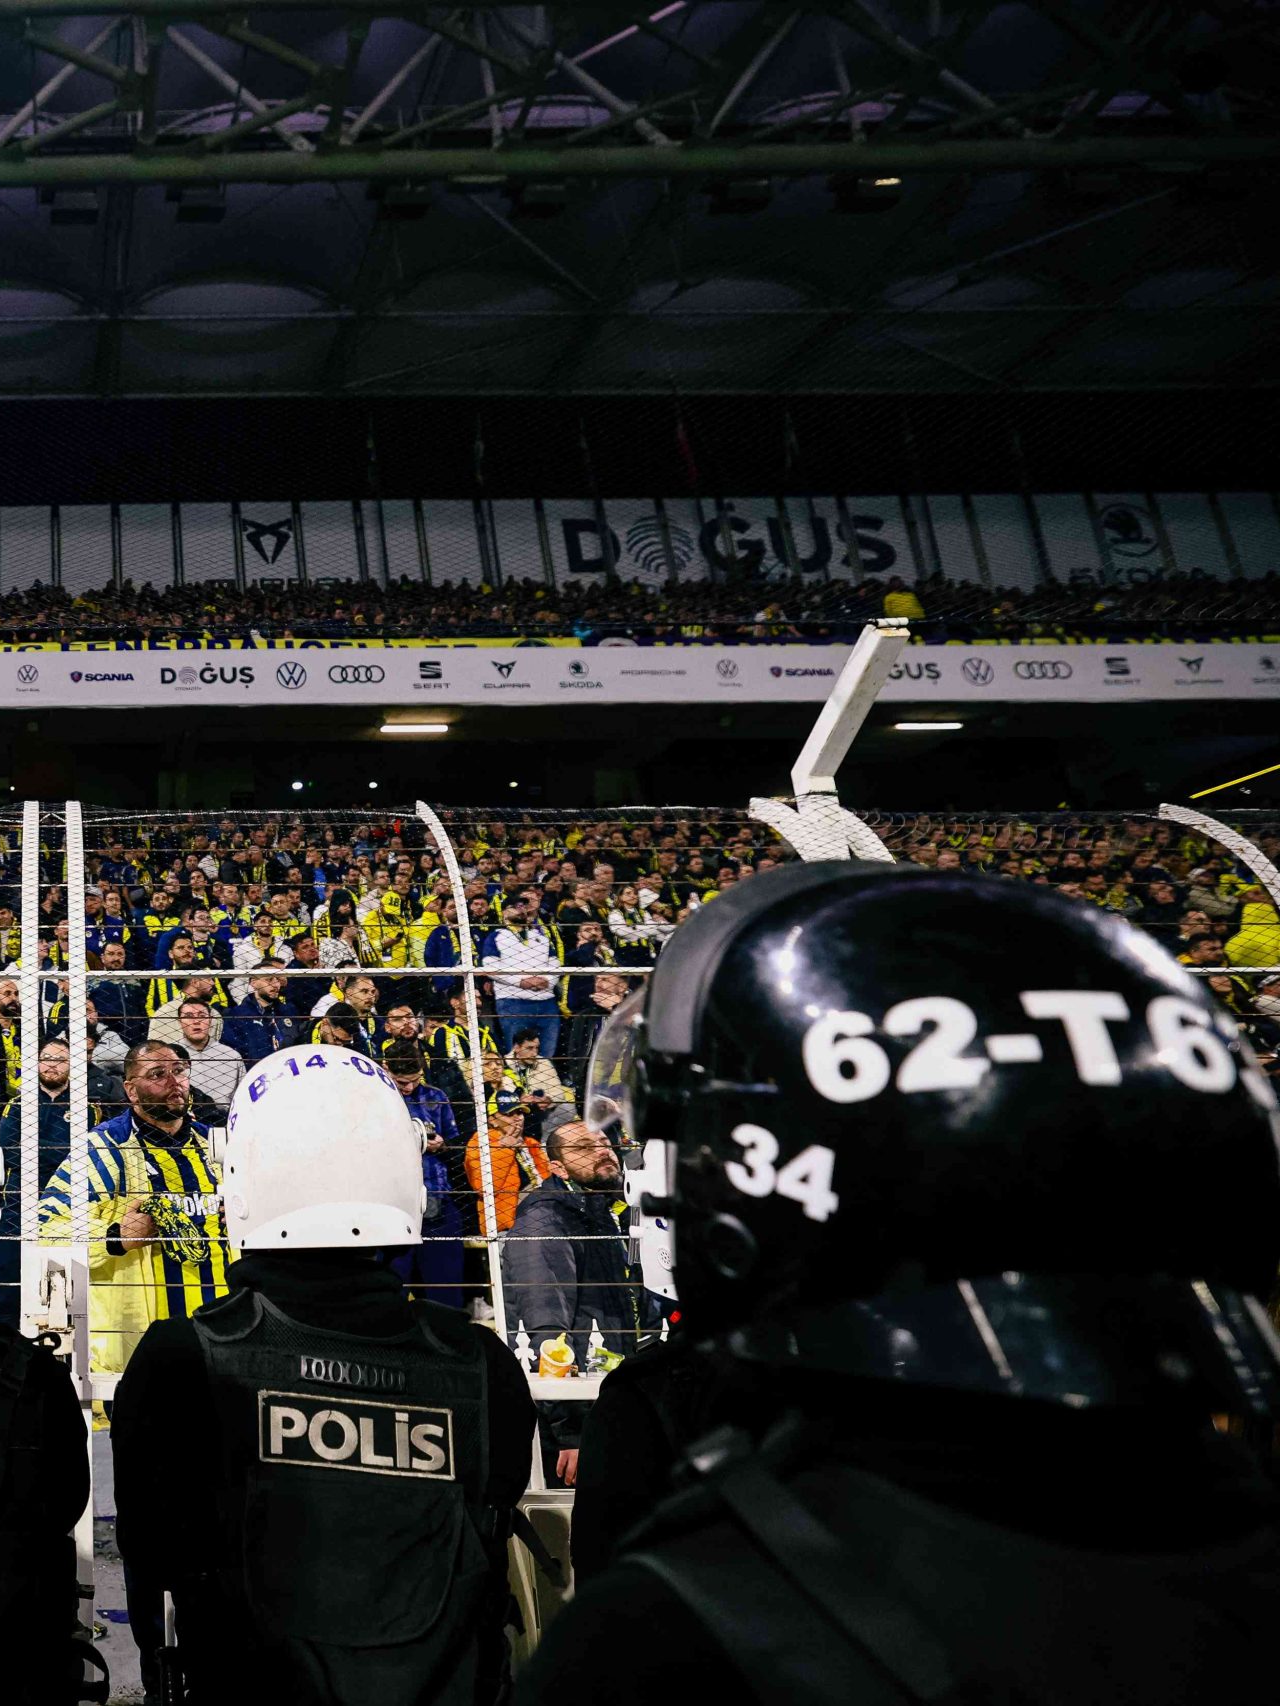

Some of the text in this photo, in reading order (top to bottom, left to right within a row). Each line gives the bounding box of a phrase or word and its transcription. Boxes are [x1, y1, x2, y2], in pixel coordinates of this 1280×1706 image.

[85, 673, 134, 681] SCANIA
[785, 668, 835, 676] SCANIA
[725, 1122, 839, 1222] 34
[270, 1405, 447, 1472] POLİS
